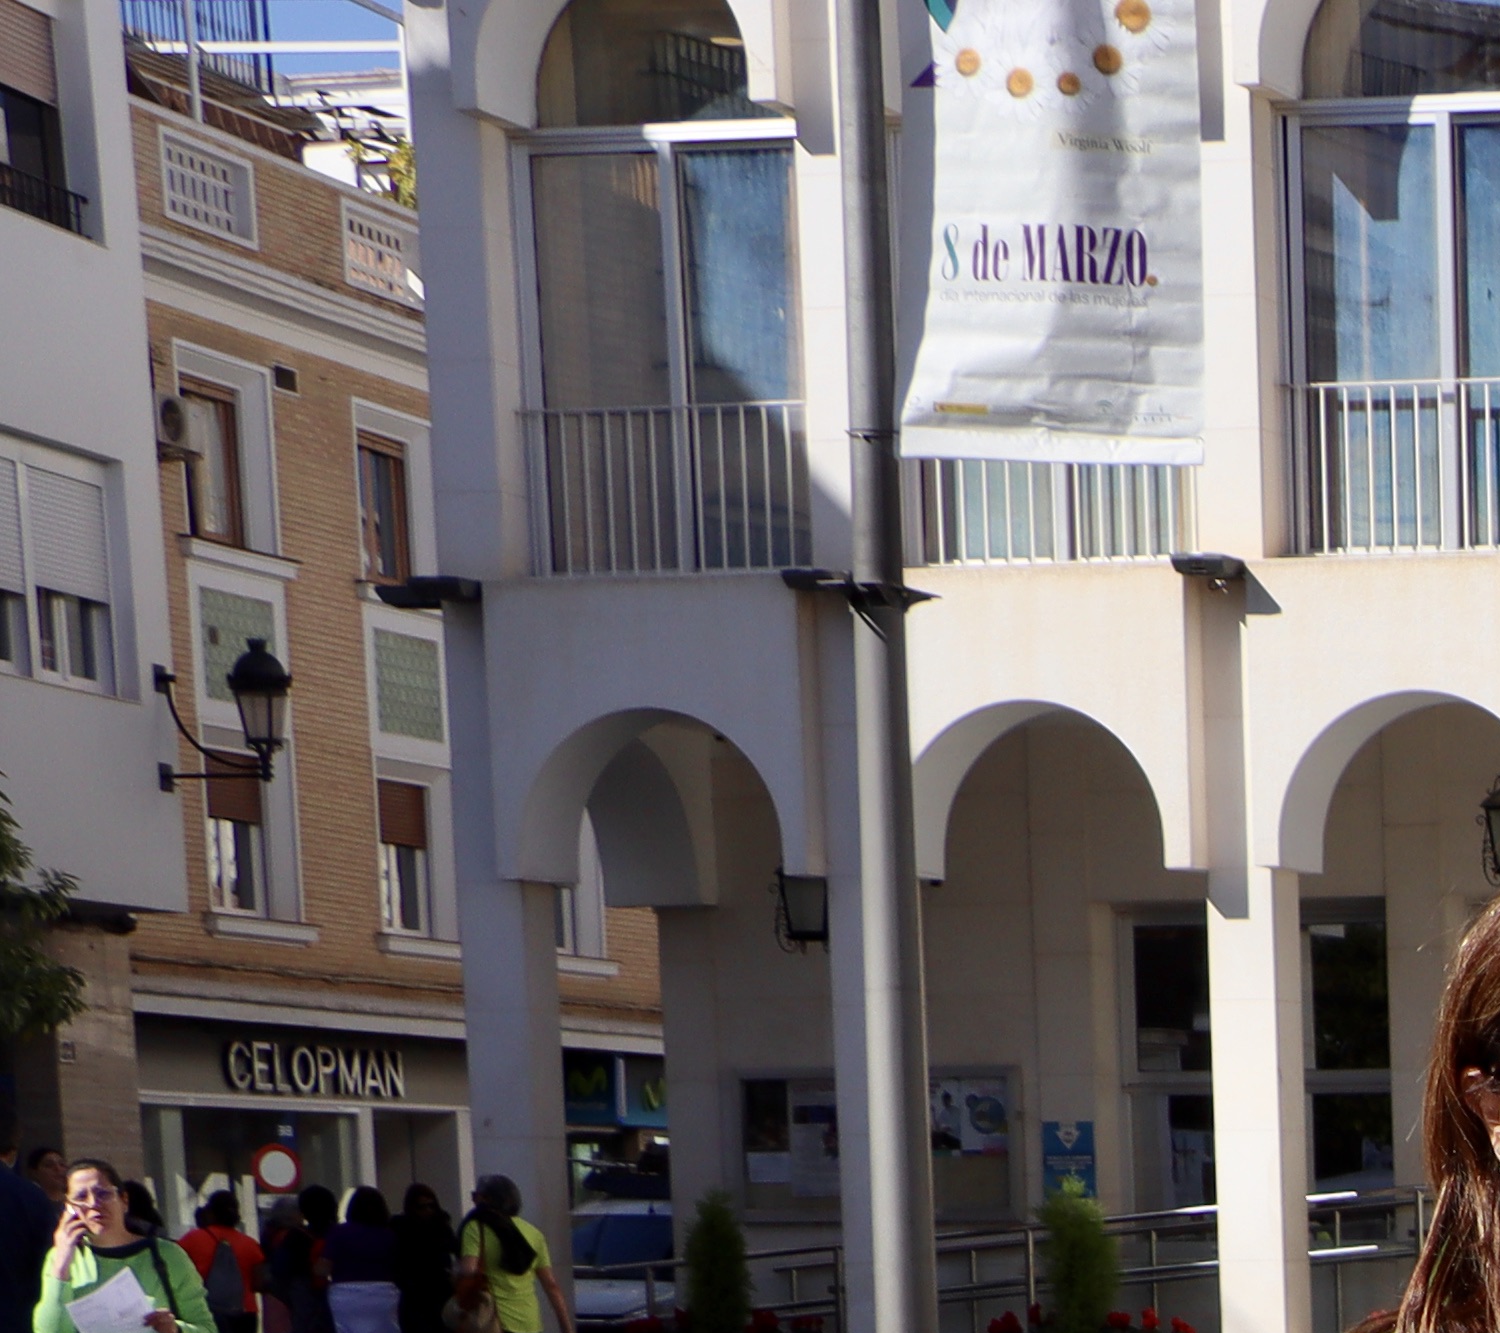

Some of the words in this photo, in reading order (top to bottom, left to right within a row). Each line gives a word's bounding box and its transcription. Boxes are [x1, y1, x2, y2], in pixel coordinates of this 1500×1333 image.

[942, 223, 959, 281] 8
[972, 223, 1010, 282] de
[963, 289, 1045, 303] internacional
[228, 1041, 405, 1099] CELOPMAN
